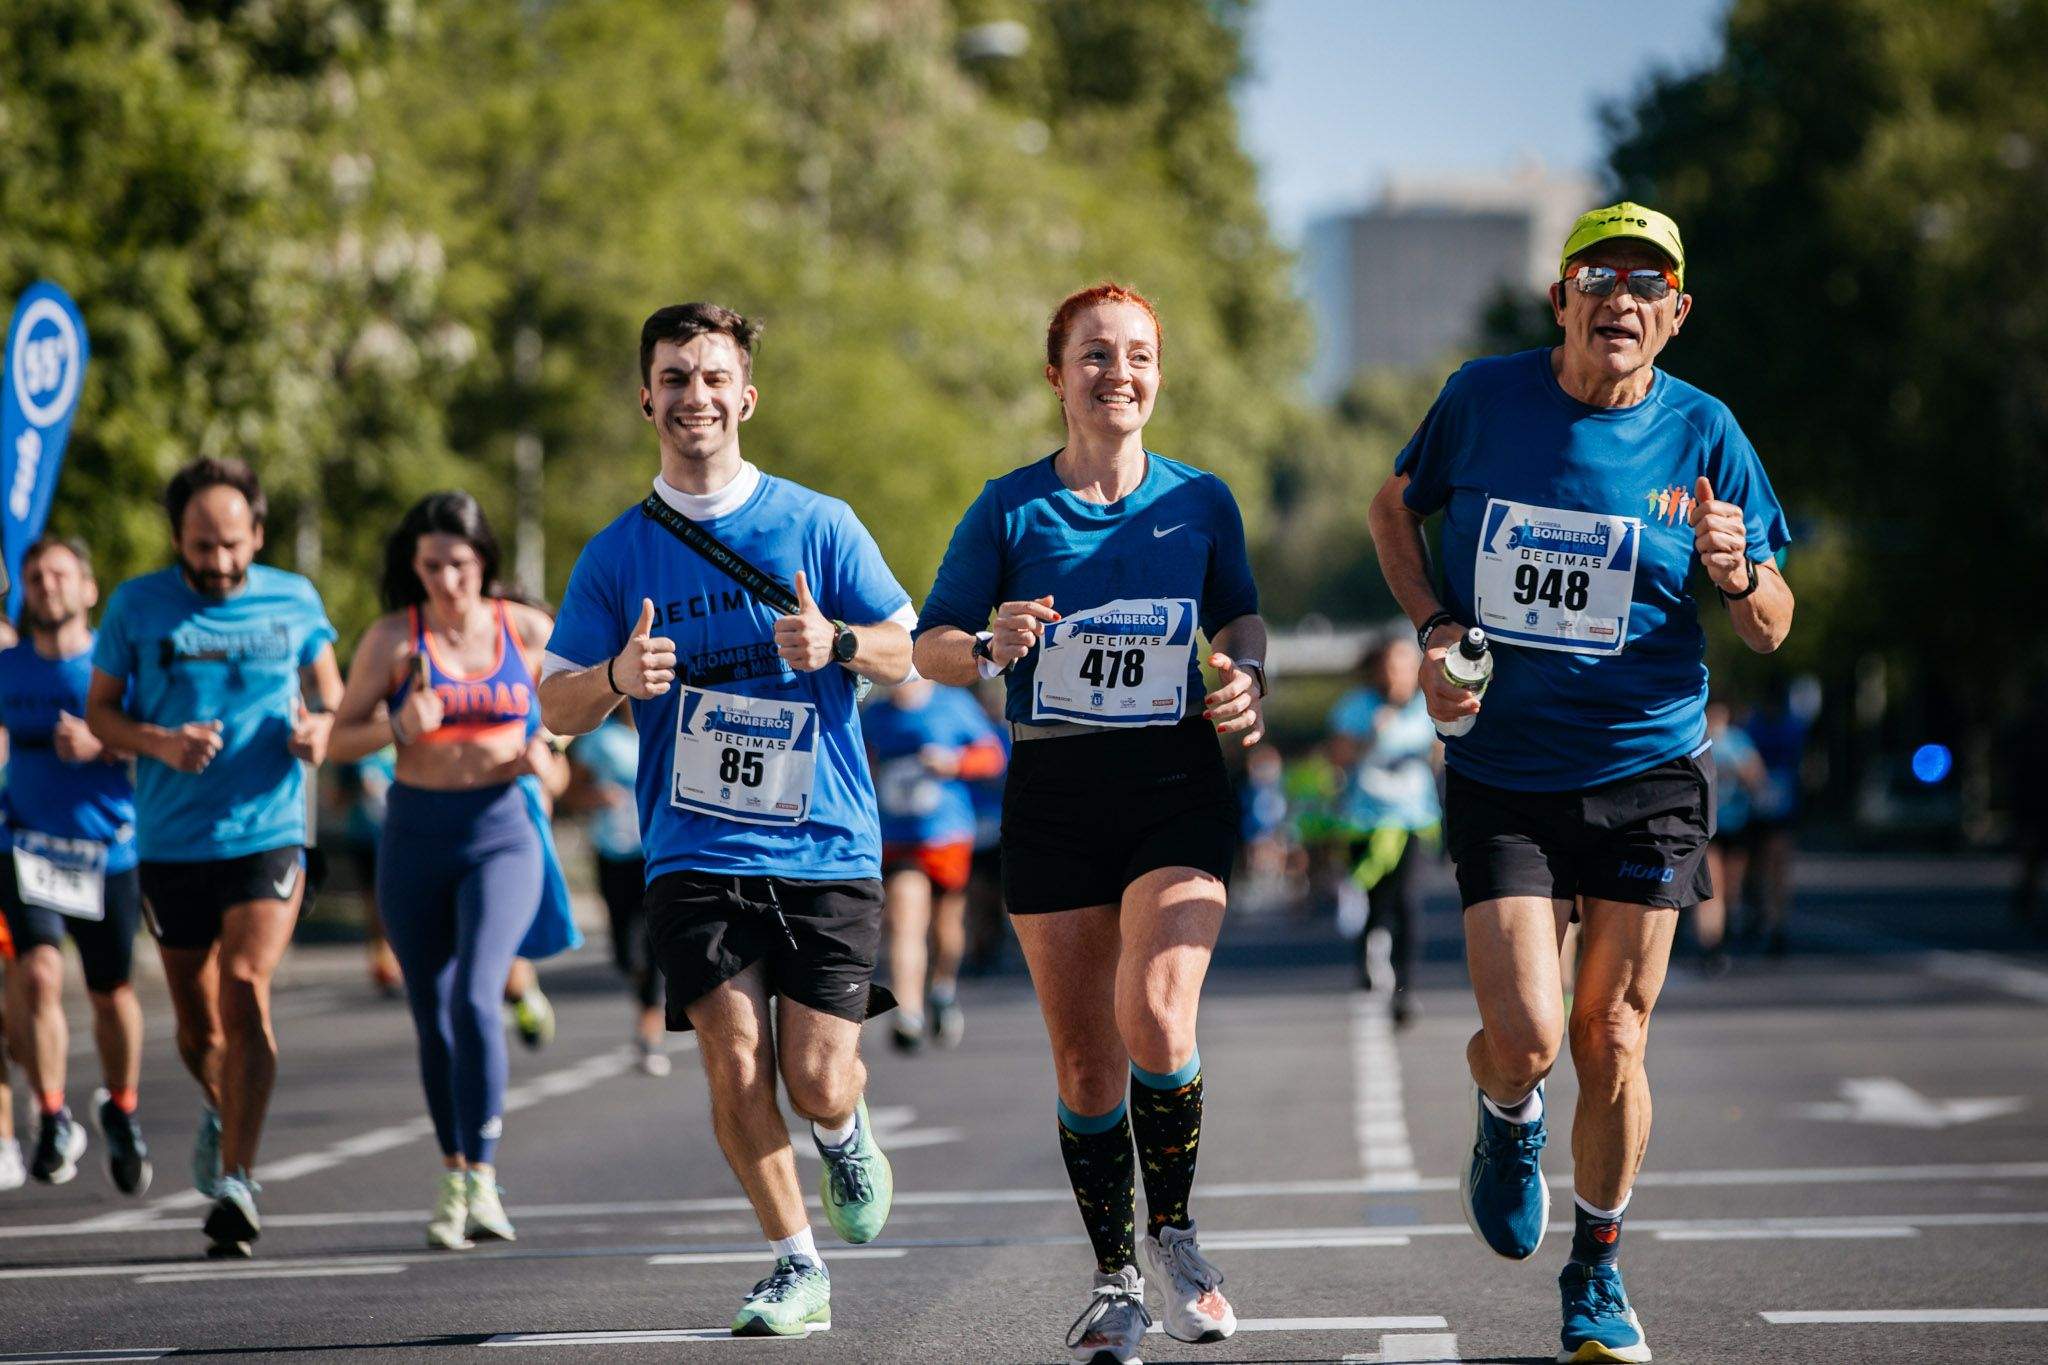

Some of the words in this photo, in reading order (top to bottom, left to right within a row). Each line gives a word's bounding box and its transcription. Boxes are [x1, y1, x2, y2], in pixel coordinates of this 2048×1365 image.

[1532, 527, 1606, 546] BOMBEROS
[1521, 549, 1602, 569] DECIMAS
[1513, 563, 1590, 611] 948
[1093, 614, 1166, 626] BOMBEROS
[1083, 635, 1161, 647] DECIMAS
[1080, 649, 1146, 689] 478
[434, 682, 530, 716] DIDAS
[724, 713, 791, 729] BOMBEROS
[715, 732, 787, 750] DECIMAS
[720, 747, 765, 788] 85
